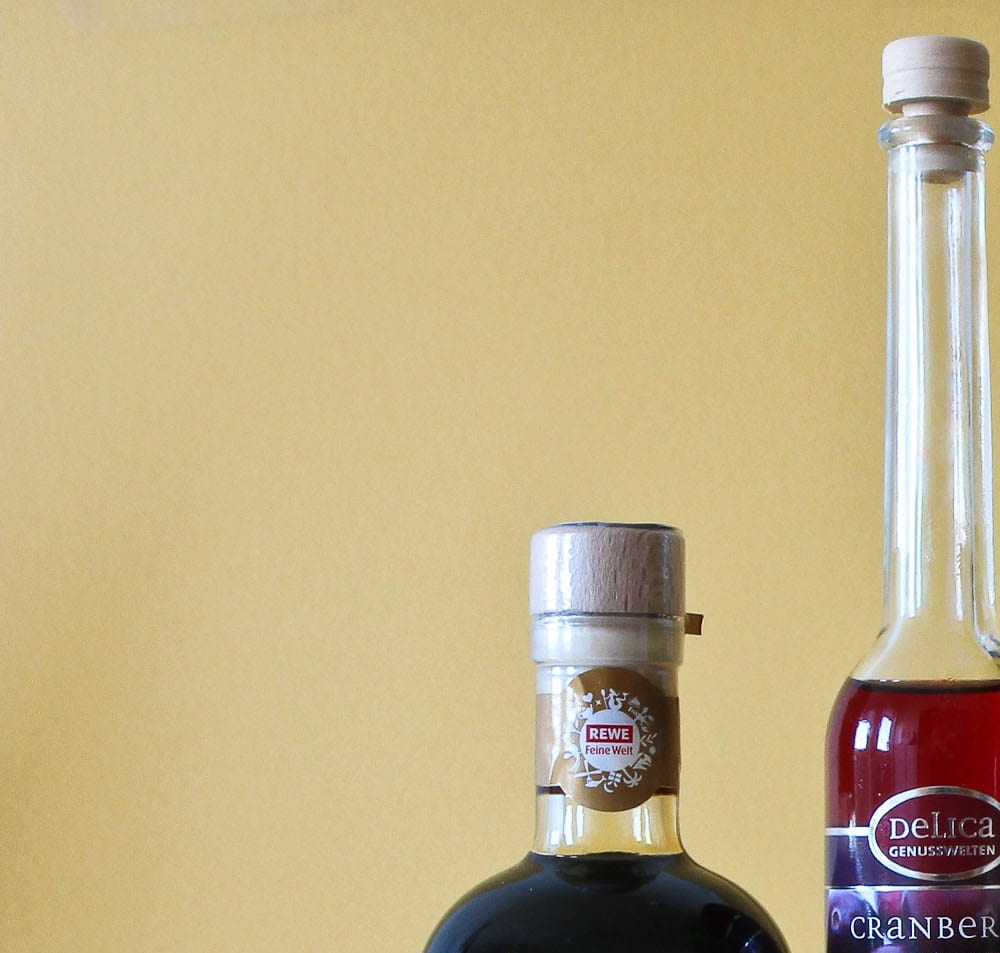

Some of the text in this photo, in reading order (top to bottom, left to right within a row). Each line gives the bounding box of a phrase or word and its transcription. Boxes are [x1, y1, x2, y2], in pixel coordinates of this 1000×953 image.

[589, 728, 630, 740] REWE
[585, 745, 633, 756] Feine Welt
[889, 844, 996, 858] GENUSSWELTEN
